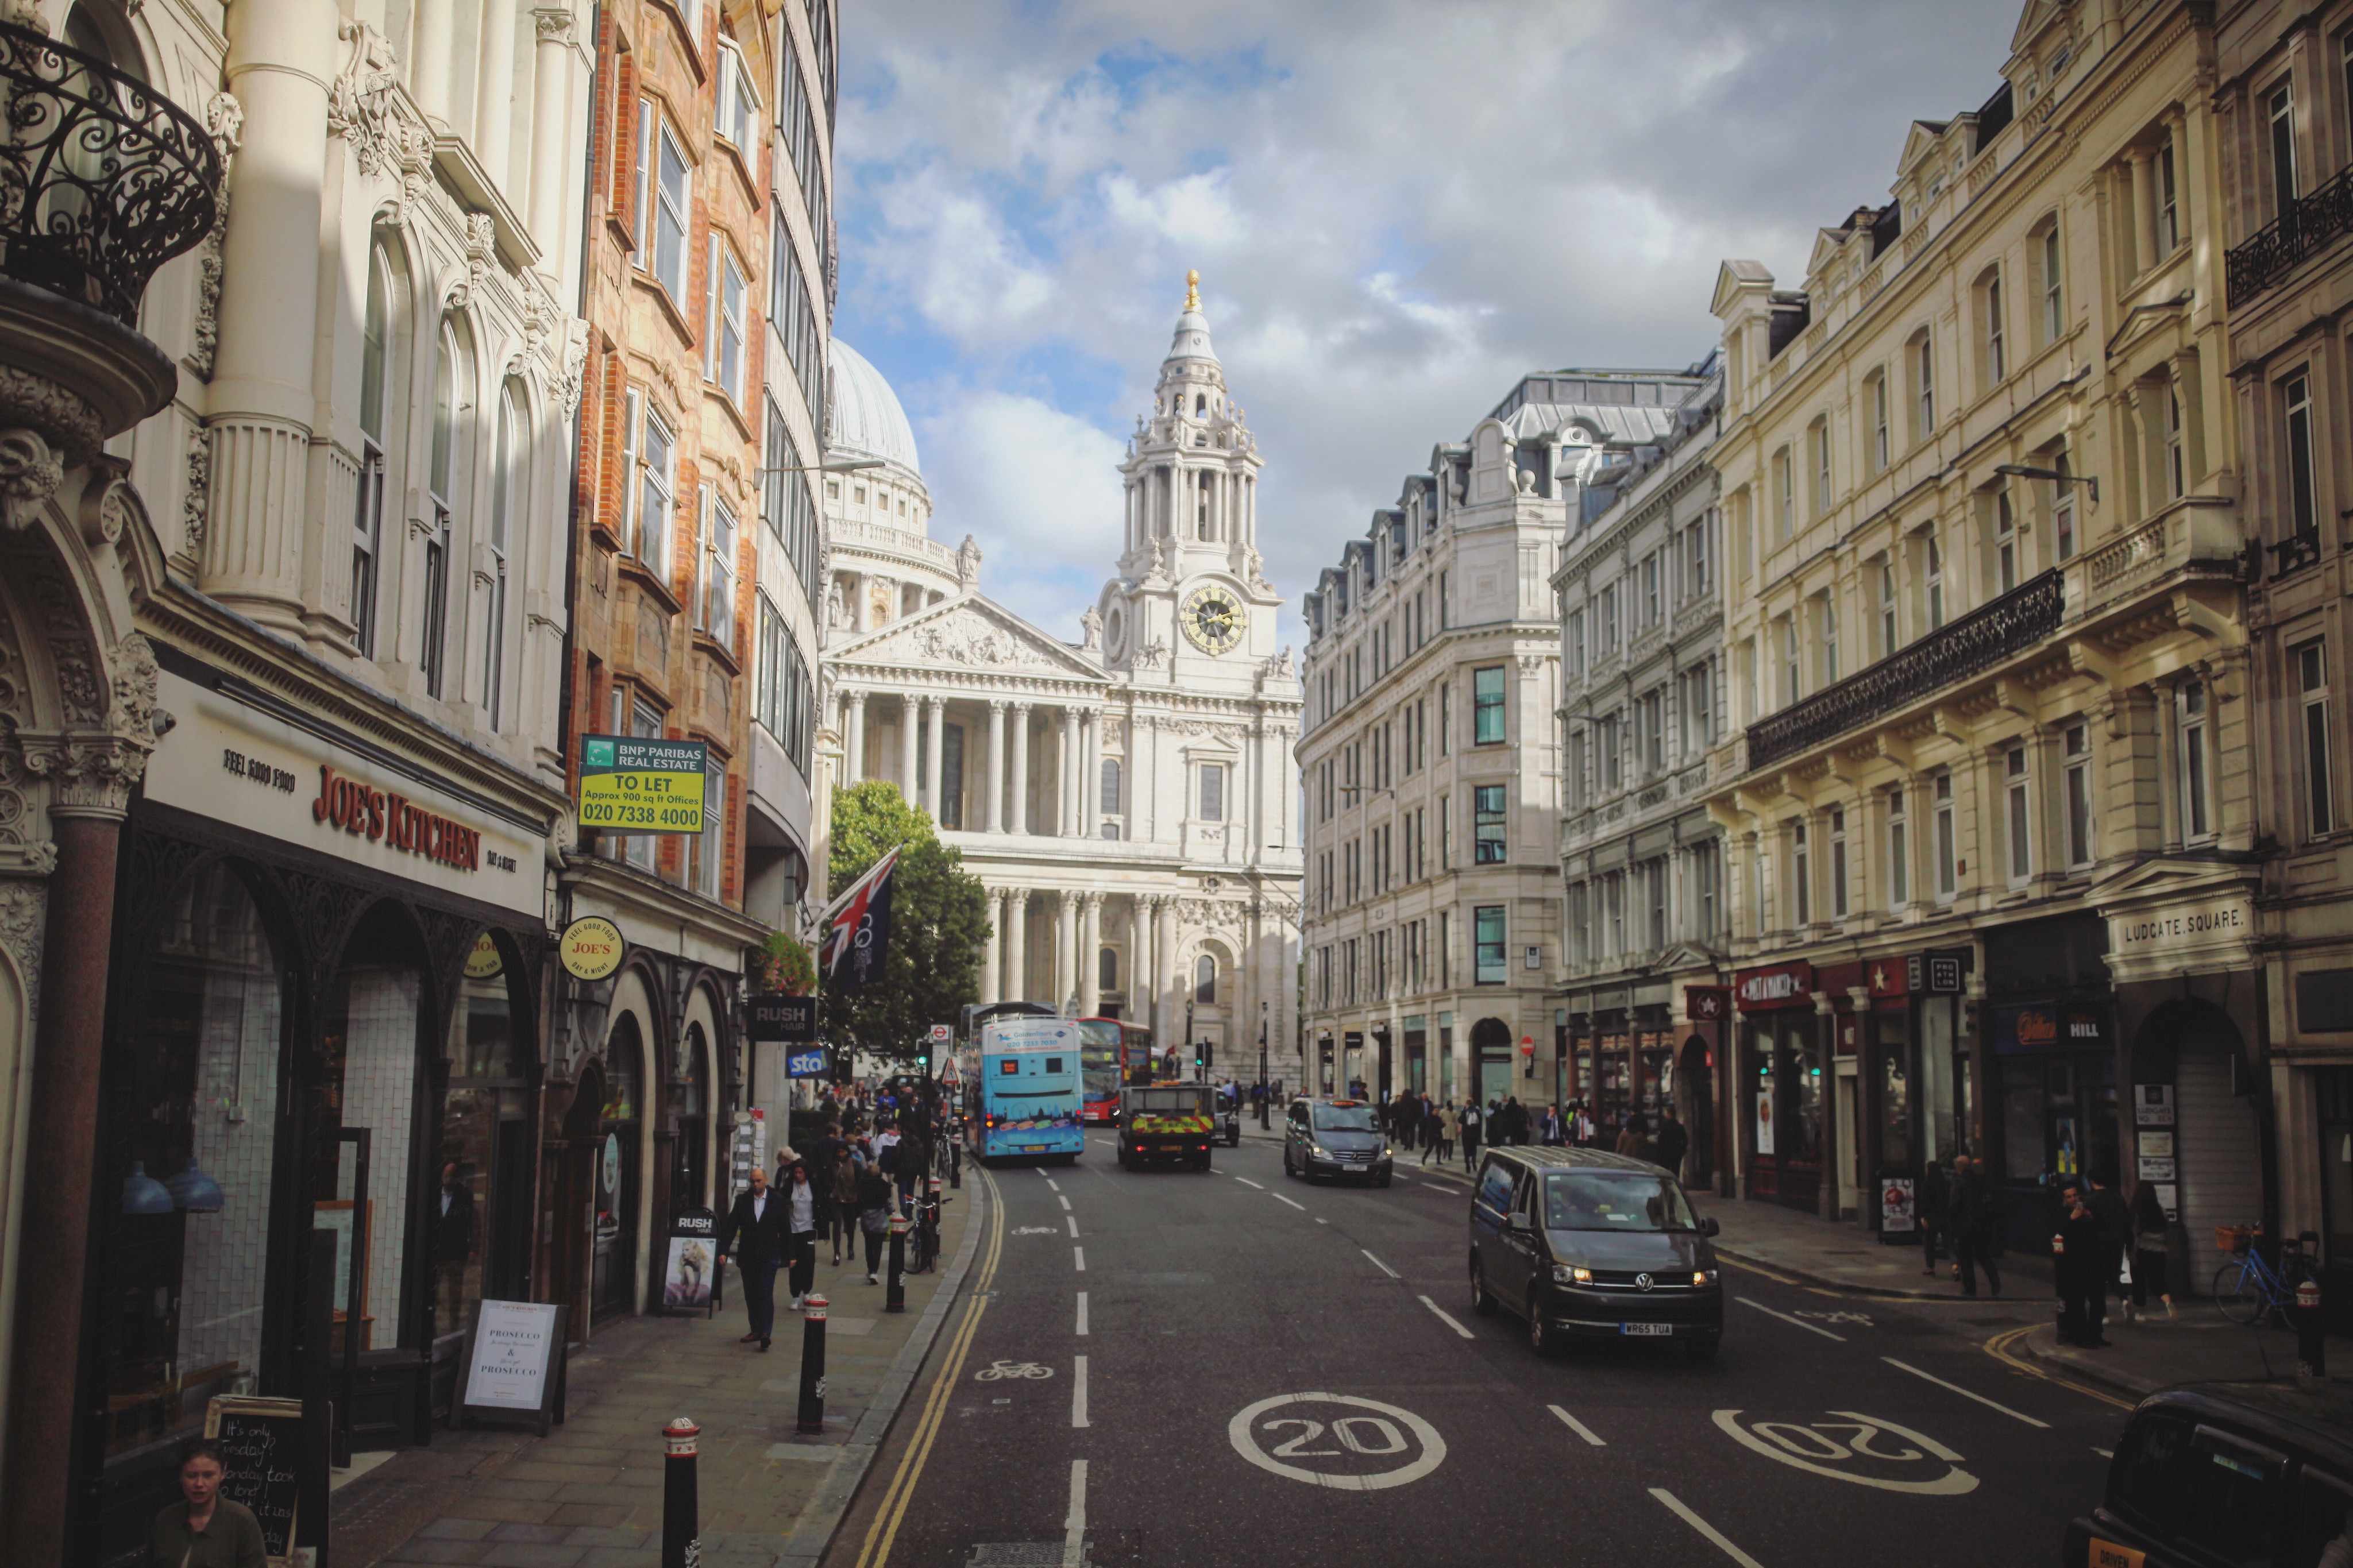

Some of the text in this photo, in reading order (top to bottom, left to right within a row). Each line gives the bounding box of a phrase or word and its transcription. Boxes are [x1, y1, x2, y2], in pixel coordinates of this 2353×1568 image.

[619, 744, 701, 760] BNP PARIBAS
[619, 756, 697, 770] REAL ESTATE
[223, 749, 295, 793] FEEL GOOD FOOD
[615, 775, 672, 792] TO LET
[585, 790, 699, 805] Approx 900 sq ft Offices
[314, 764, 481, 871] JOE'S KITCHEN
[584, 803, 698, 826] 020 7338 4000
[569, 927, 583, 941] FEEL
[601, 926, 615, 941] FOOD
[572, 942, 610, 955] JOE'S
[572, 961, 583, 972] DAY
[591, 962, 608, 974] NIGHT
[756, 1007, 806, 1021] RUSH
[780, 1022, 805, 1031] HAIR
[2070, 1024, 2099, 1037] HILL
[790, 1053, 822, 1073] sta
[678, 1218, 712, 1228] RUSH
[489, 1330, 540, 1340] PROSECCO
[1626, 1324, 1670, 1334] WR65 TUA
[508, 1348, 515, 1356] &
[481, 1365, 537, 1376] PROSECCO
[227, 1419, 271, 1449] It's only
[1263, 1417, 1408, 1457] 20
[1752, 1422, 1923, 1460] 20
[223, 1462, 297, 1490] onday took
[234, 1482, 259, 1505] long
[259, 1501, 270, 1516] it
[273, 1508, 291, 1518] was
[2100, 1550, 2130, 1568] DRIVEN
